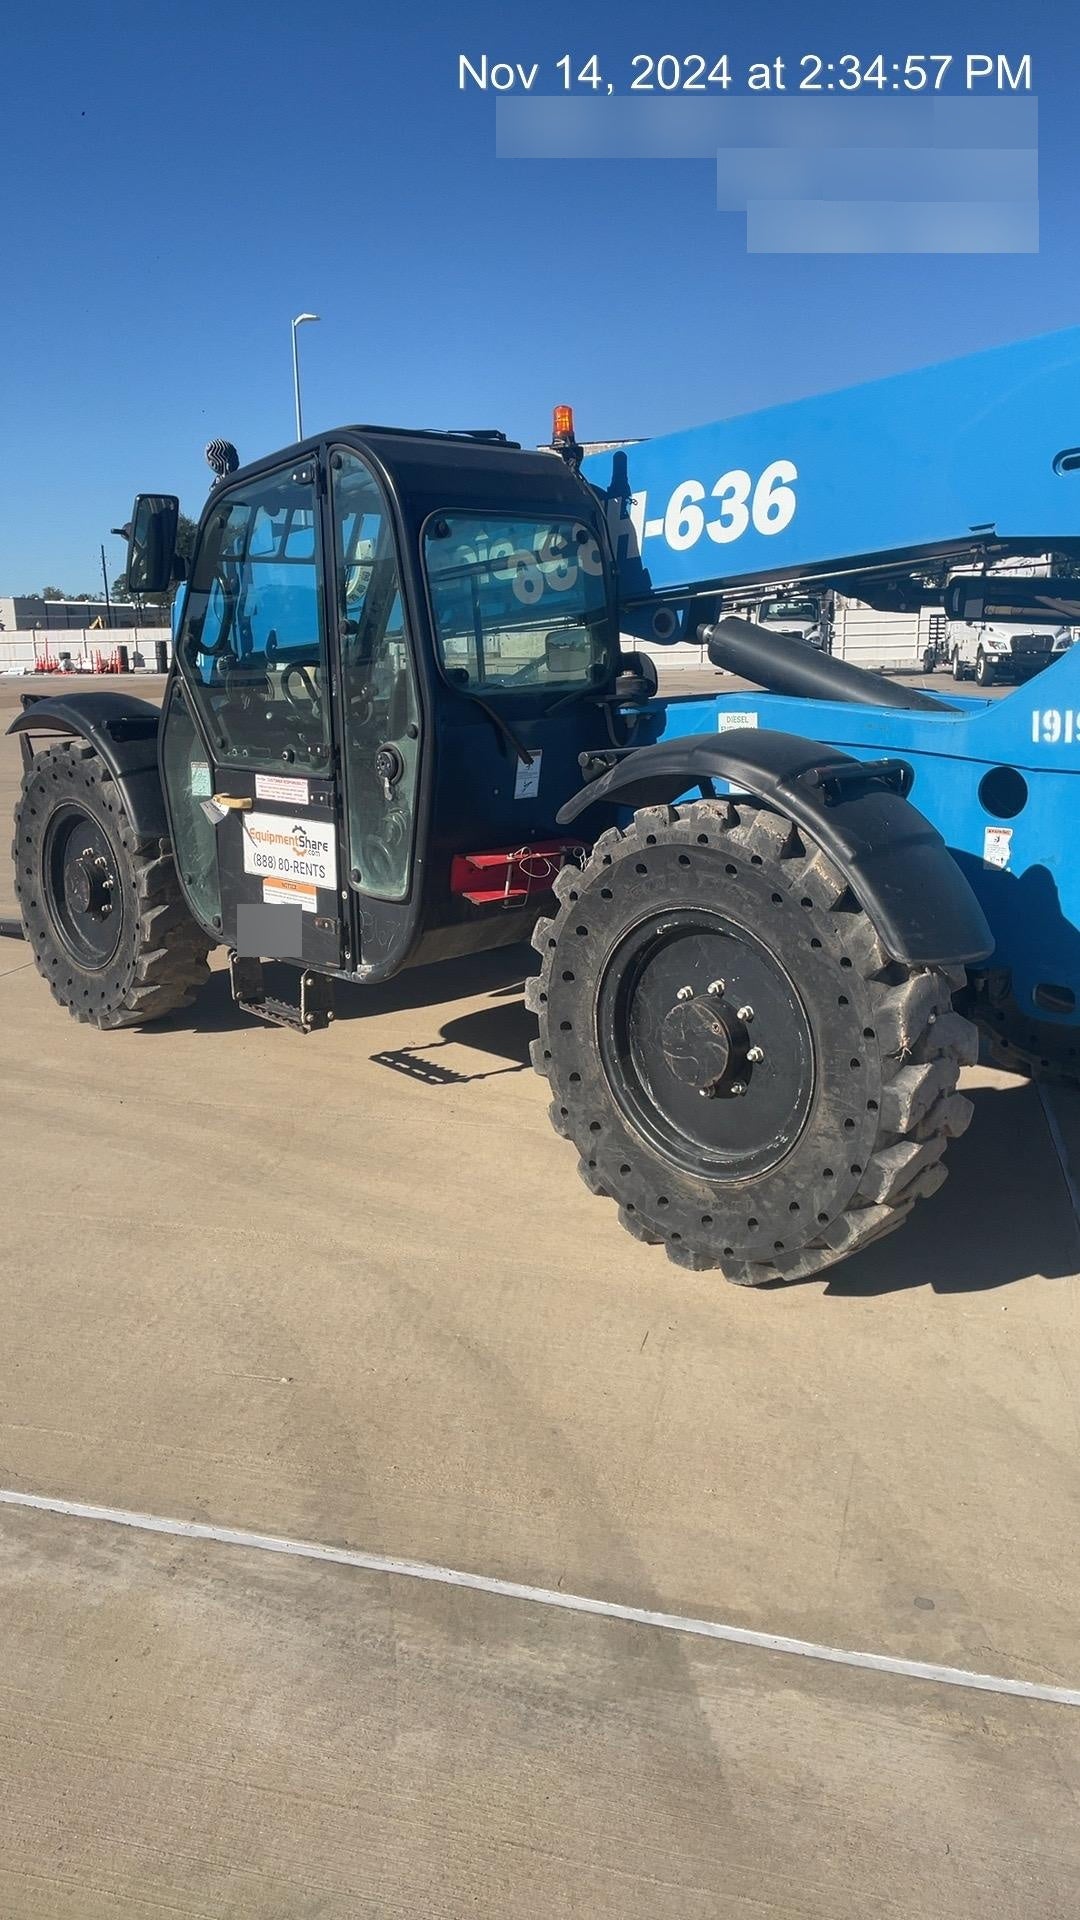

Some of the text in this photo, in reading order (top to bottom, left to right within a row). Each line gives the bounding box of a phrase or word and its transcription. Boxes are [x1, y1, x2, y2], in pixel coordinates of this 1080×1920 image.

[726, 715, 750, 724] DIESEL
[1032, 708, 1080, 744] 191
[249, 827, 329, 852] EquipmentShare
[253, 852, 326, 879] (888) 80-RENTS
